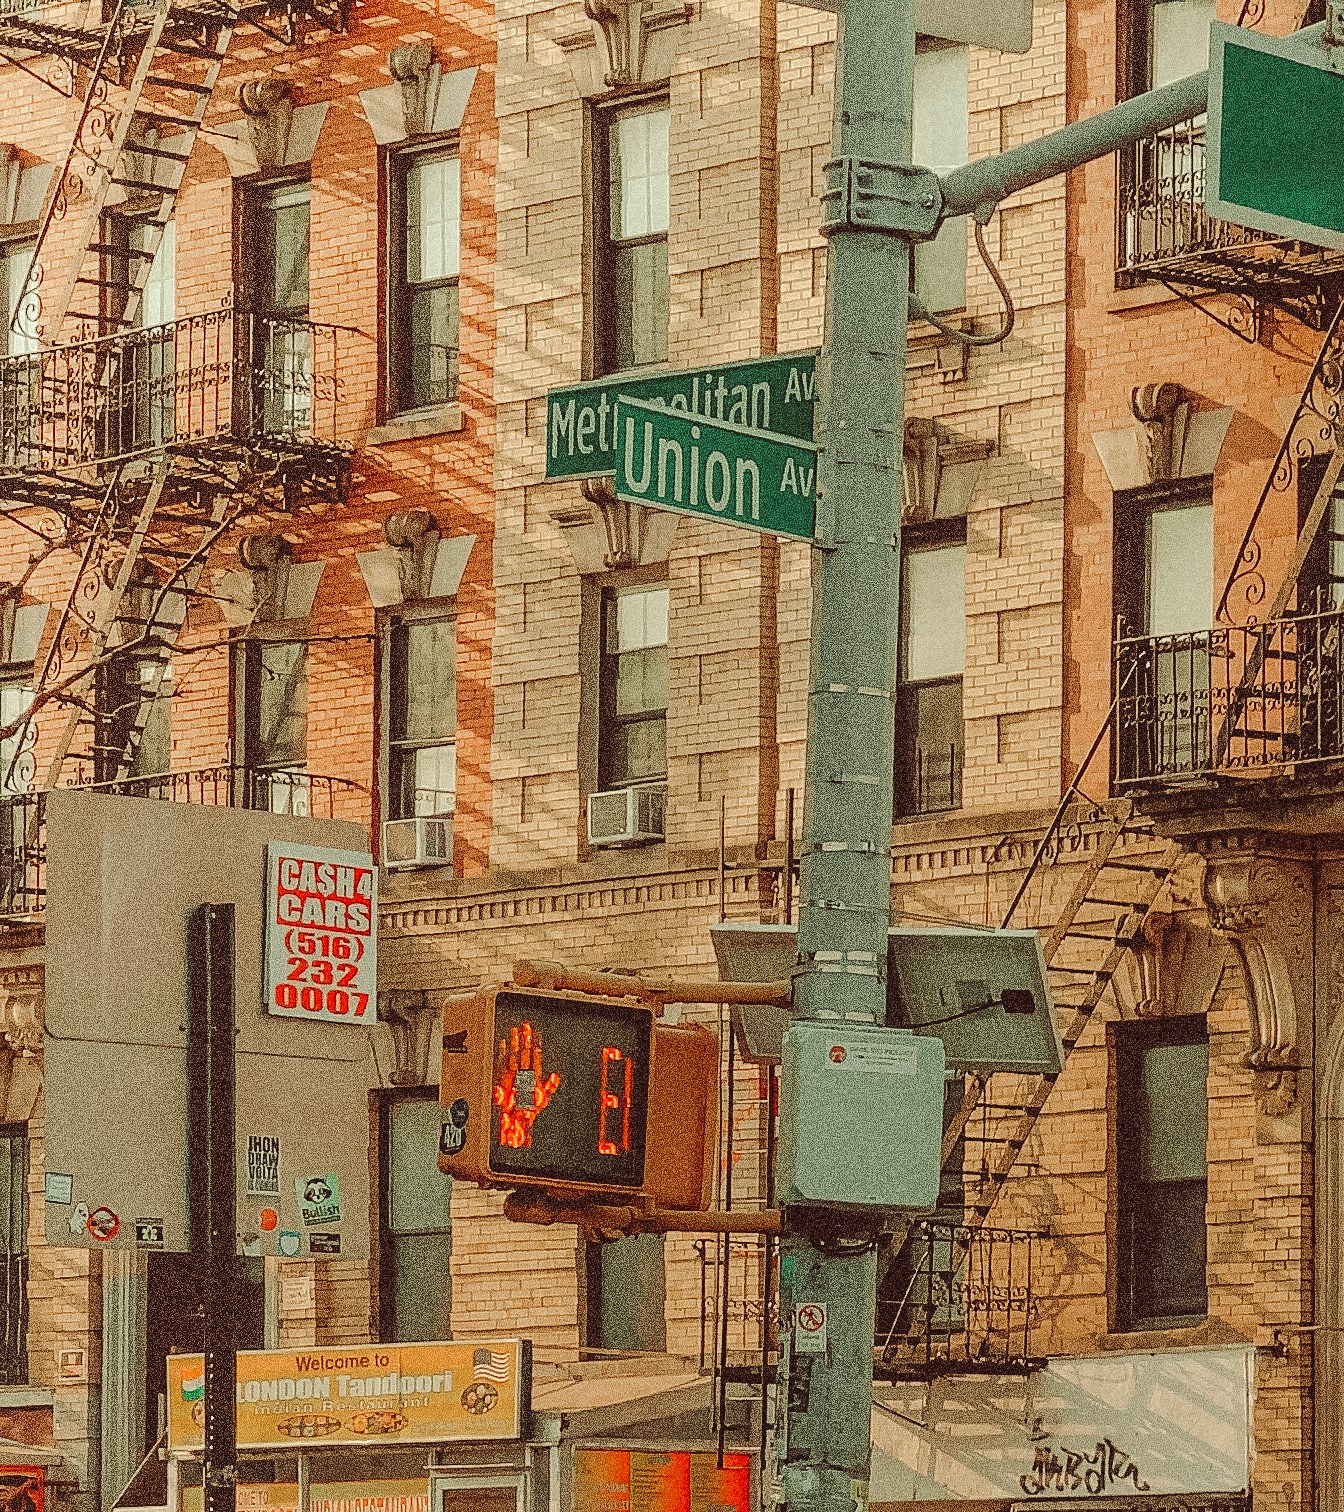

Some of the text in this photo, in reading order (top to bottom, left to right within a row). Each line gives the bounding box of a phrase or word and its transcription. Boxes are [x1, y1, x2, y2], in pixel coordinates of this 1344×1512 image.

[551, 374, 770, 458] Metlitan
[625, 417, 760, 520] Union
[279, 893, 371, 932] CARS
[284, 928, 365, 963] (516)
[286, 956, 359, 989] 232
[275, 983, 370, 1018] 0007
[302, 1205, 340, 1219] Bullish
[296, 1353, 390, 1373] Welcome to
[236, 1370, 453, 1403] LONDON Tandoori
